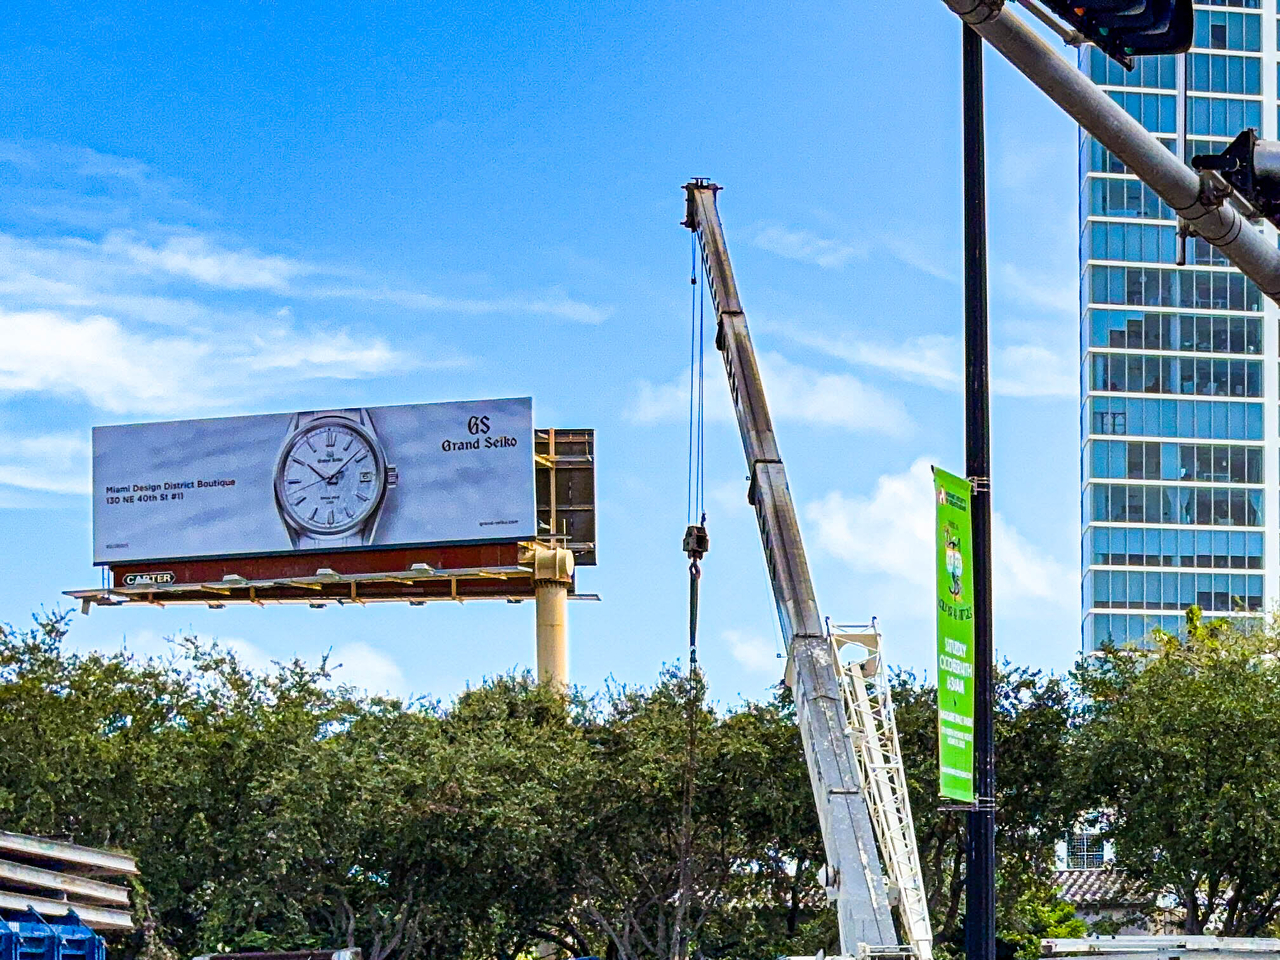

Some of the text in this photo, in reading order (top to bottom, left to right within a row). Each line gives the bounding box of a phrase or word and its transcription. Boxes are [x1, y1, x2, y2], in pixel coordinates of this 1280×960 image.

[468, 415, 491, 435] GS
[441, 435, 518, 452] Grand Seiko
[106, 478, 236, 494] Miami Design District Boutique
[106, 492, 184, 504] 130 NE 40th St #11
